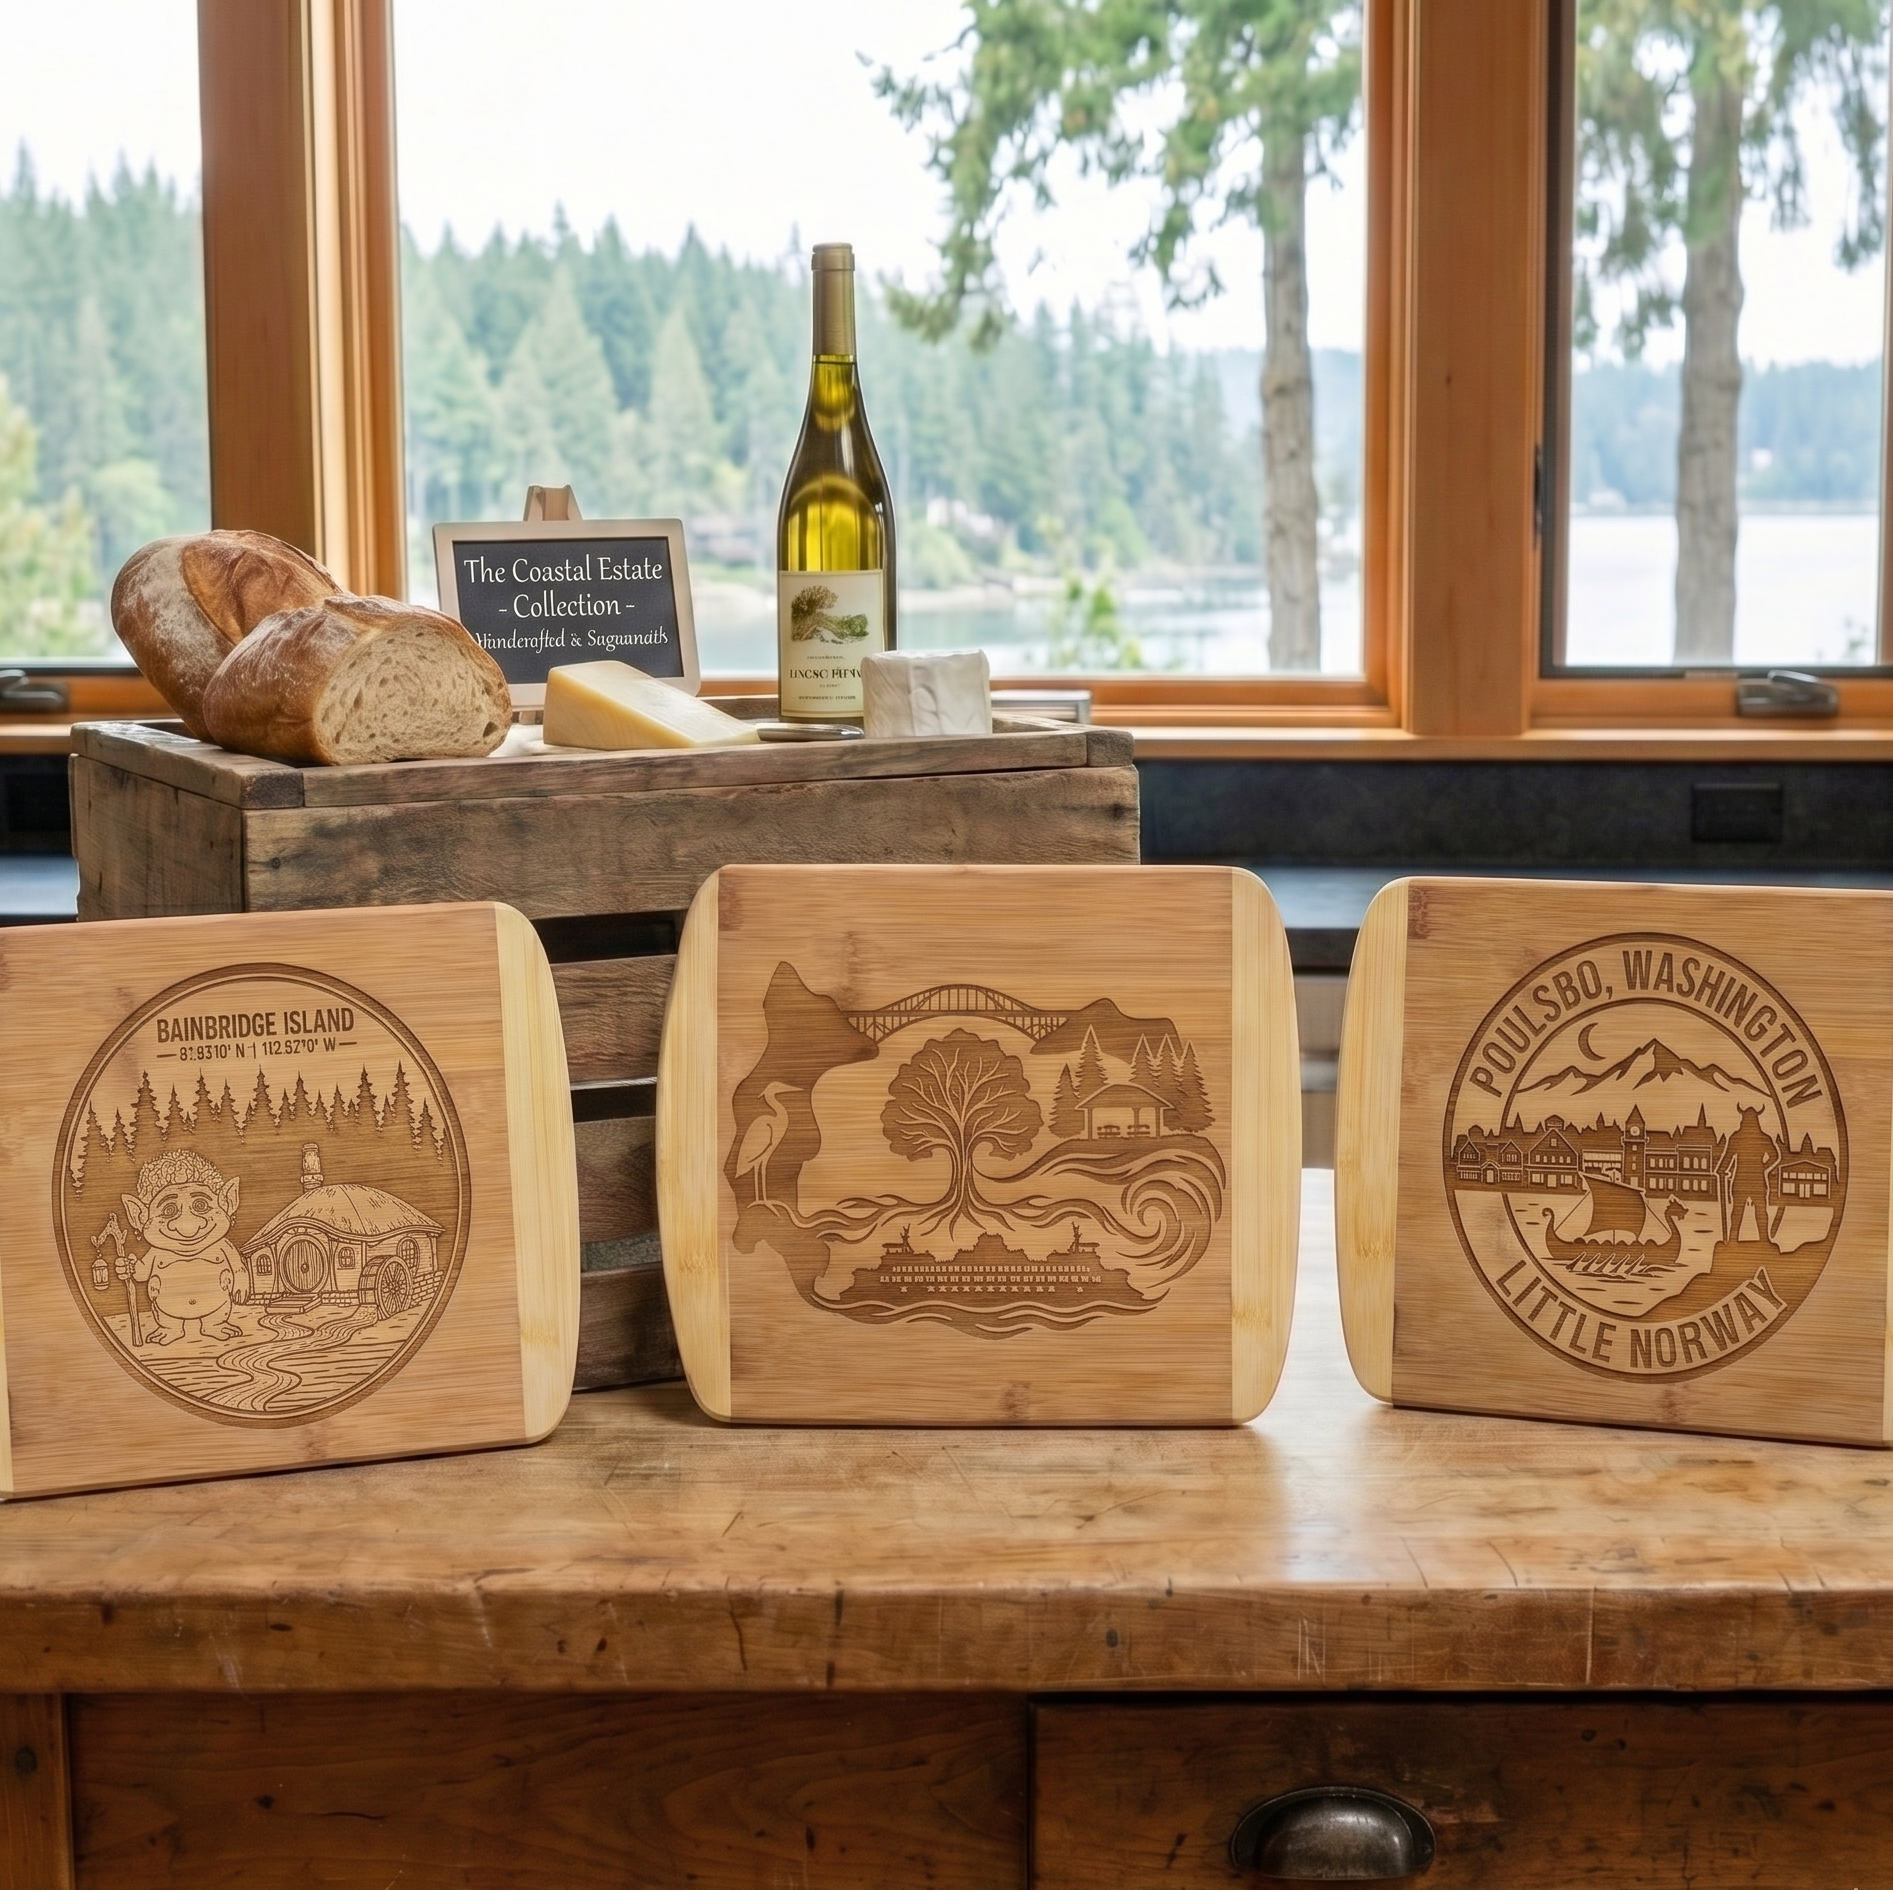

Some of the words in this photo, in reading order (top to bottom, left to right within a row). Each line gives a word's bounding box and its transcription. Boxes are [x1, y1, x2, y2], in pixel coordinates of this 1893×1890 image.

[464, 556, 506, 583] The
[512, 553, 592, 583] Coastal
[597, 557, 663, 581] Estate
[513, 589, 621, 618] Collection
[157, 1012, 277, 1043] BAINBRIDGE
[284, 1007, 355, 1035] ISLAND
[1469, 959, 1614, 1099] POULSBO,
[1622, 949, 1824, 1109] WASHINGTON
[235, 1042, 246, 1059] N
[322, 1036, 336, 1052] W
[1495, 1259, 1618, 1364] LITTLE
[1629, 1266, 1785, 1369] NORWAY
